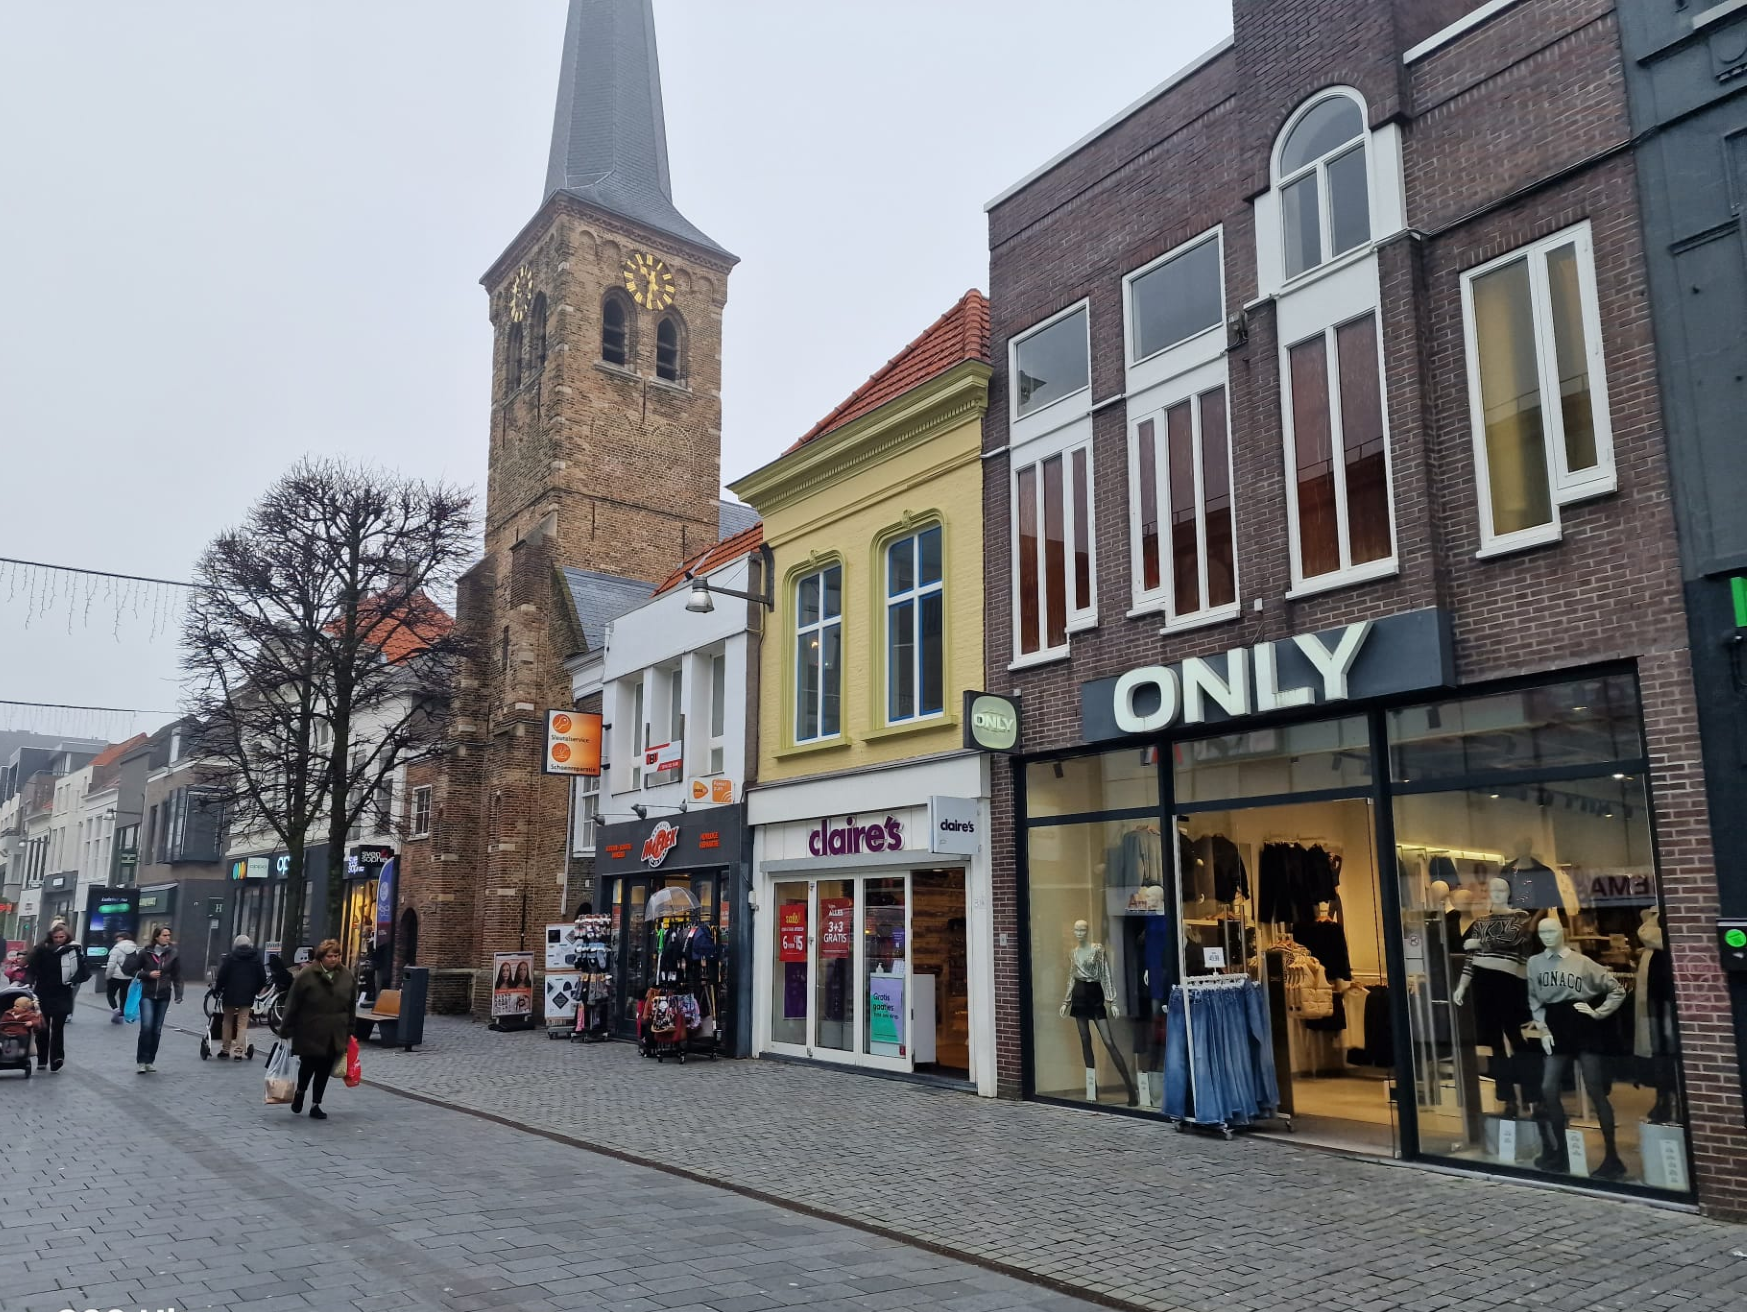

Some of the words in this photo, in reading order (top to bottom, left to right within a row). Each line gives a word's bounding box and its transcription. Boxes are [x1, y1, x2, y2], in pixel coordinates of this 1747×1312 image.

[1113, 620, 1374, 733] ONLY
[974, 713, 1014, 732] ONLY
[940, 819, 975, 833] claire's
[809, 815, 904, 857] claire's
[828, 909, 844, 917] ALLES
[828, 921, 844, 933] 3+3
[823, 933, 847, 943] GRATIS
[873, 992, 891, 1001] Gratis
